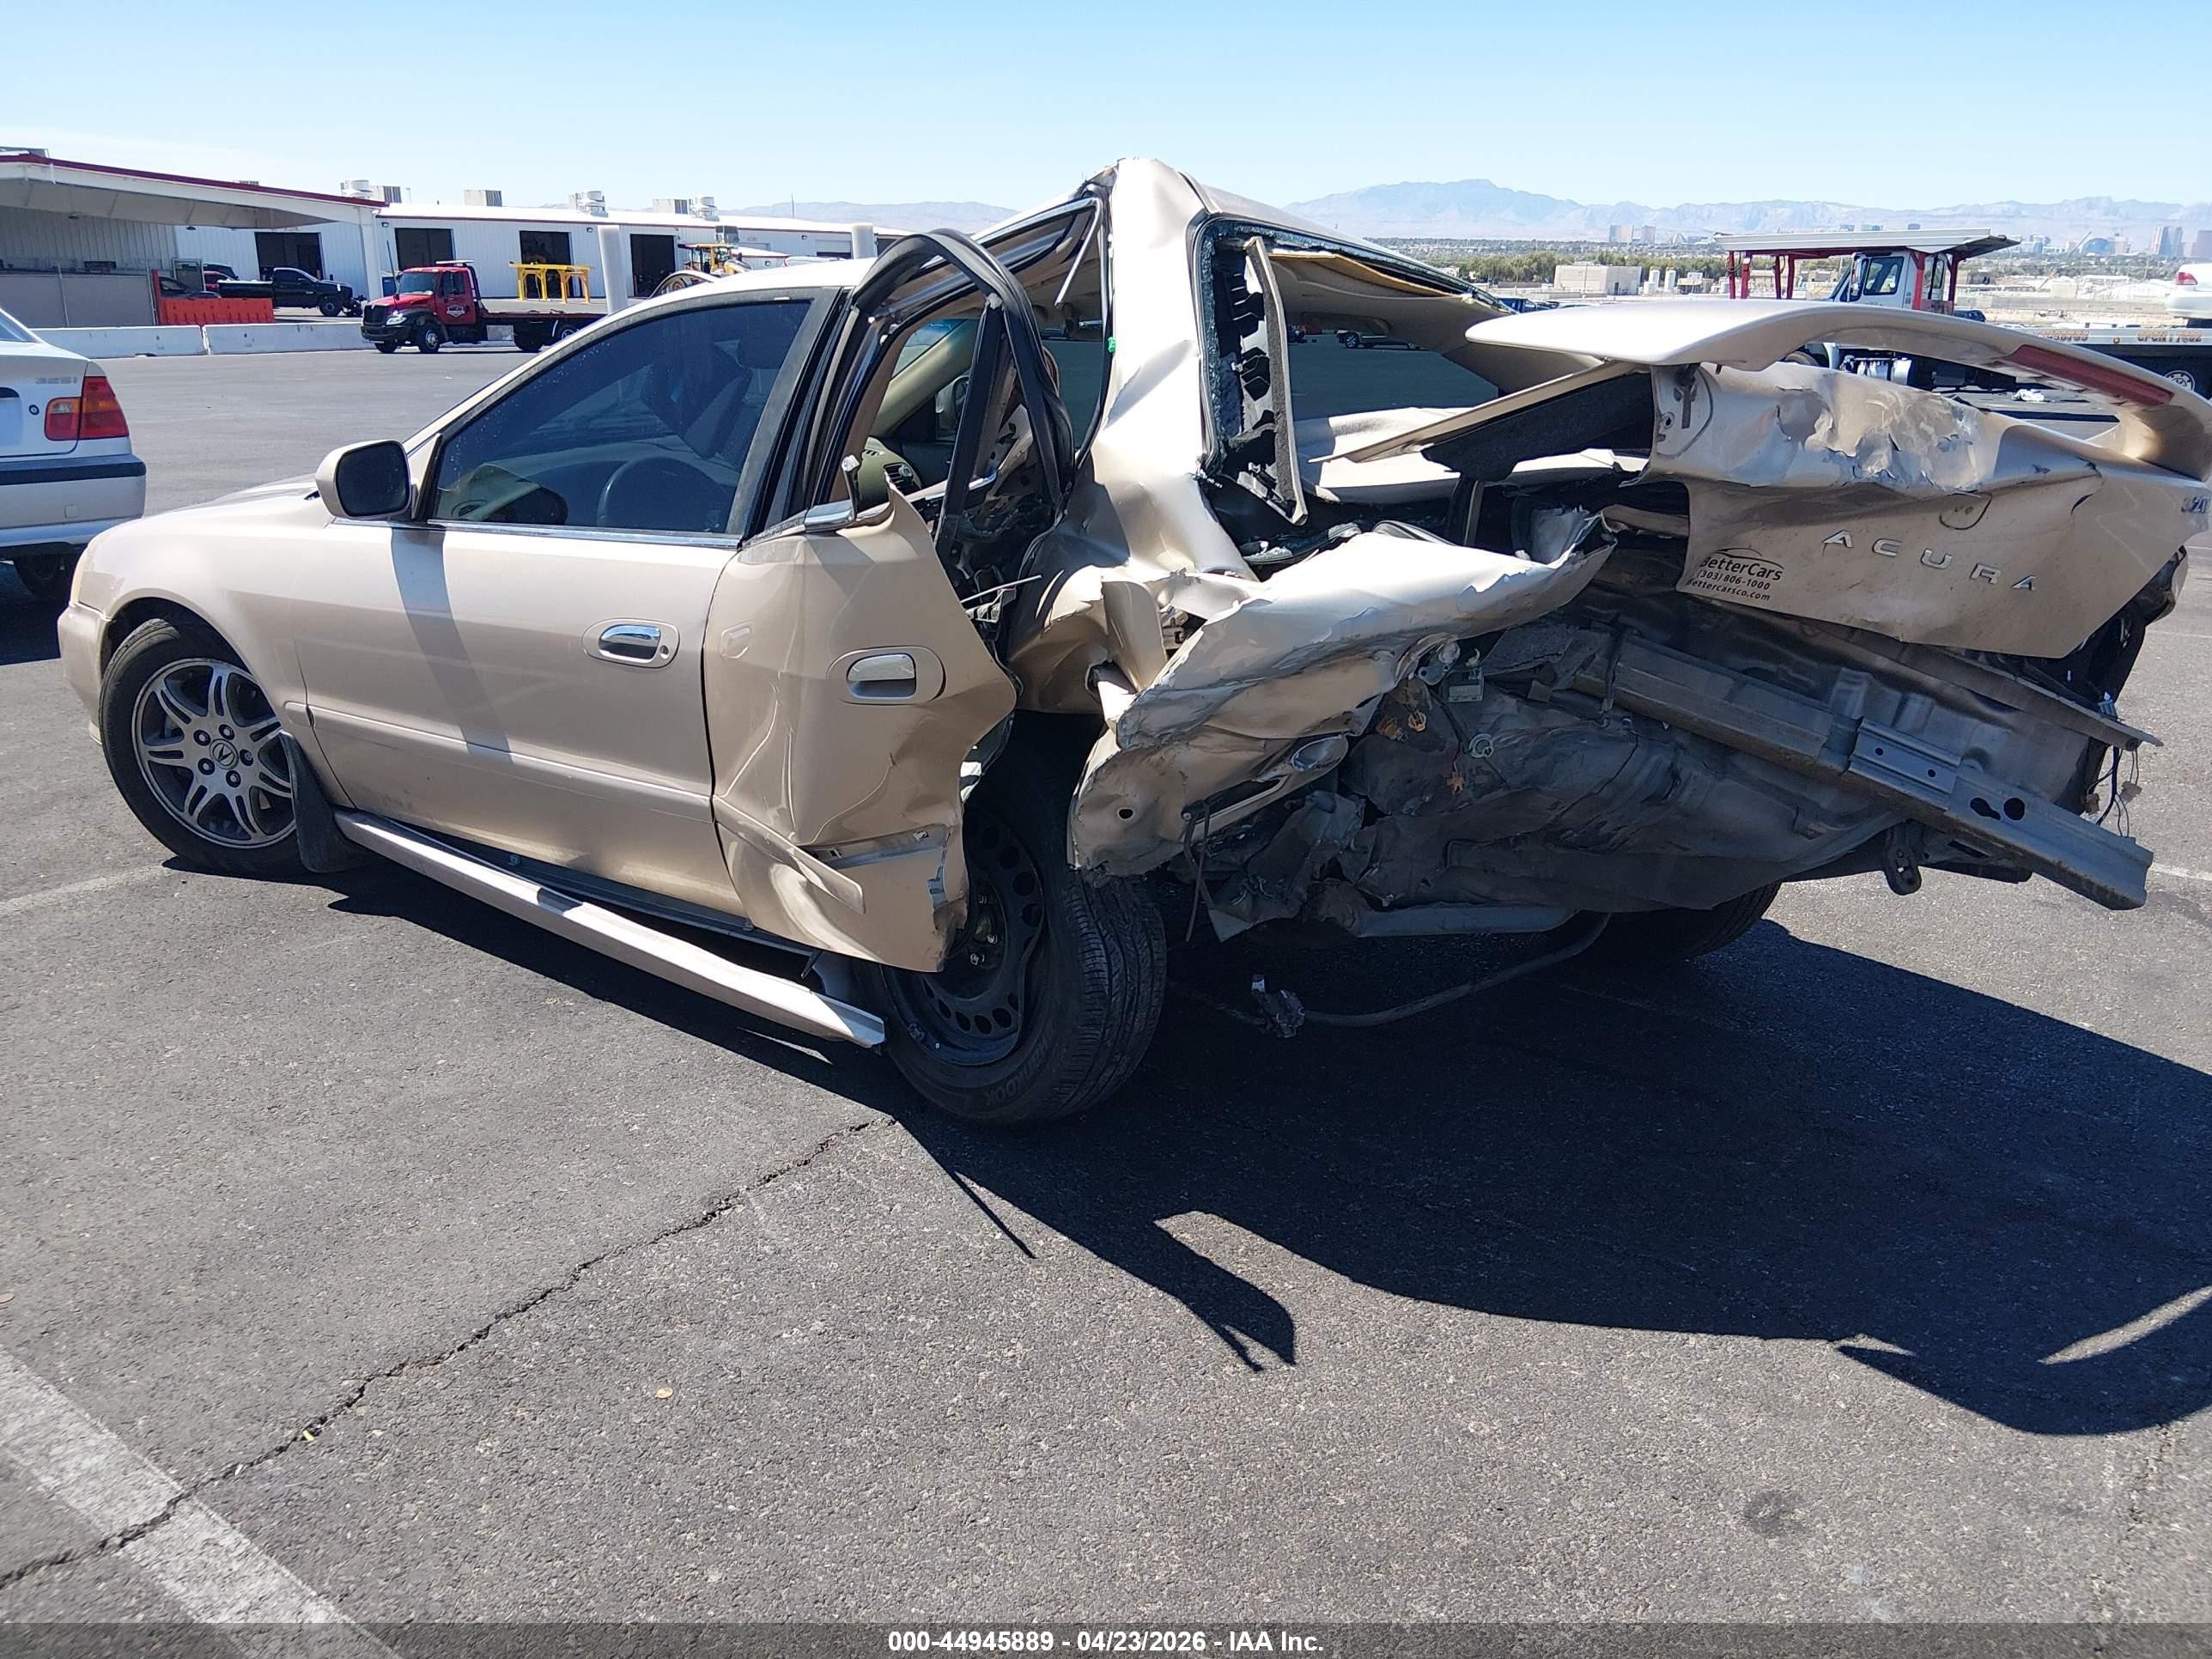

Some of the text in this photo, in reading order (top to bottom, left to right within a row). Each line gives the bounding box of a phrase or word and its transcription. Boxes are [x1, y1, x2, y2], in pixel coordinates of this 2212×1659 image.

[1699, 556, 1783, 581] BetterCars
[1821, 531, 2036, 591] ACURA
[1697, 568, 1771, 591] (303) 806-1000
